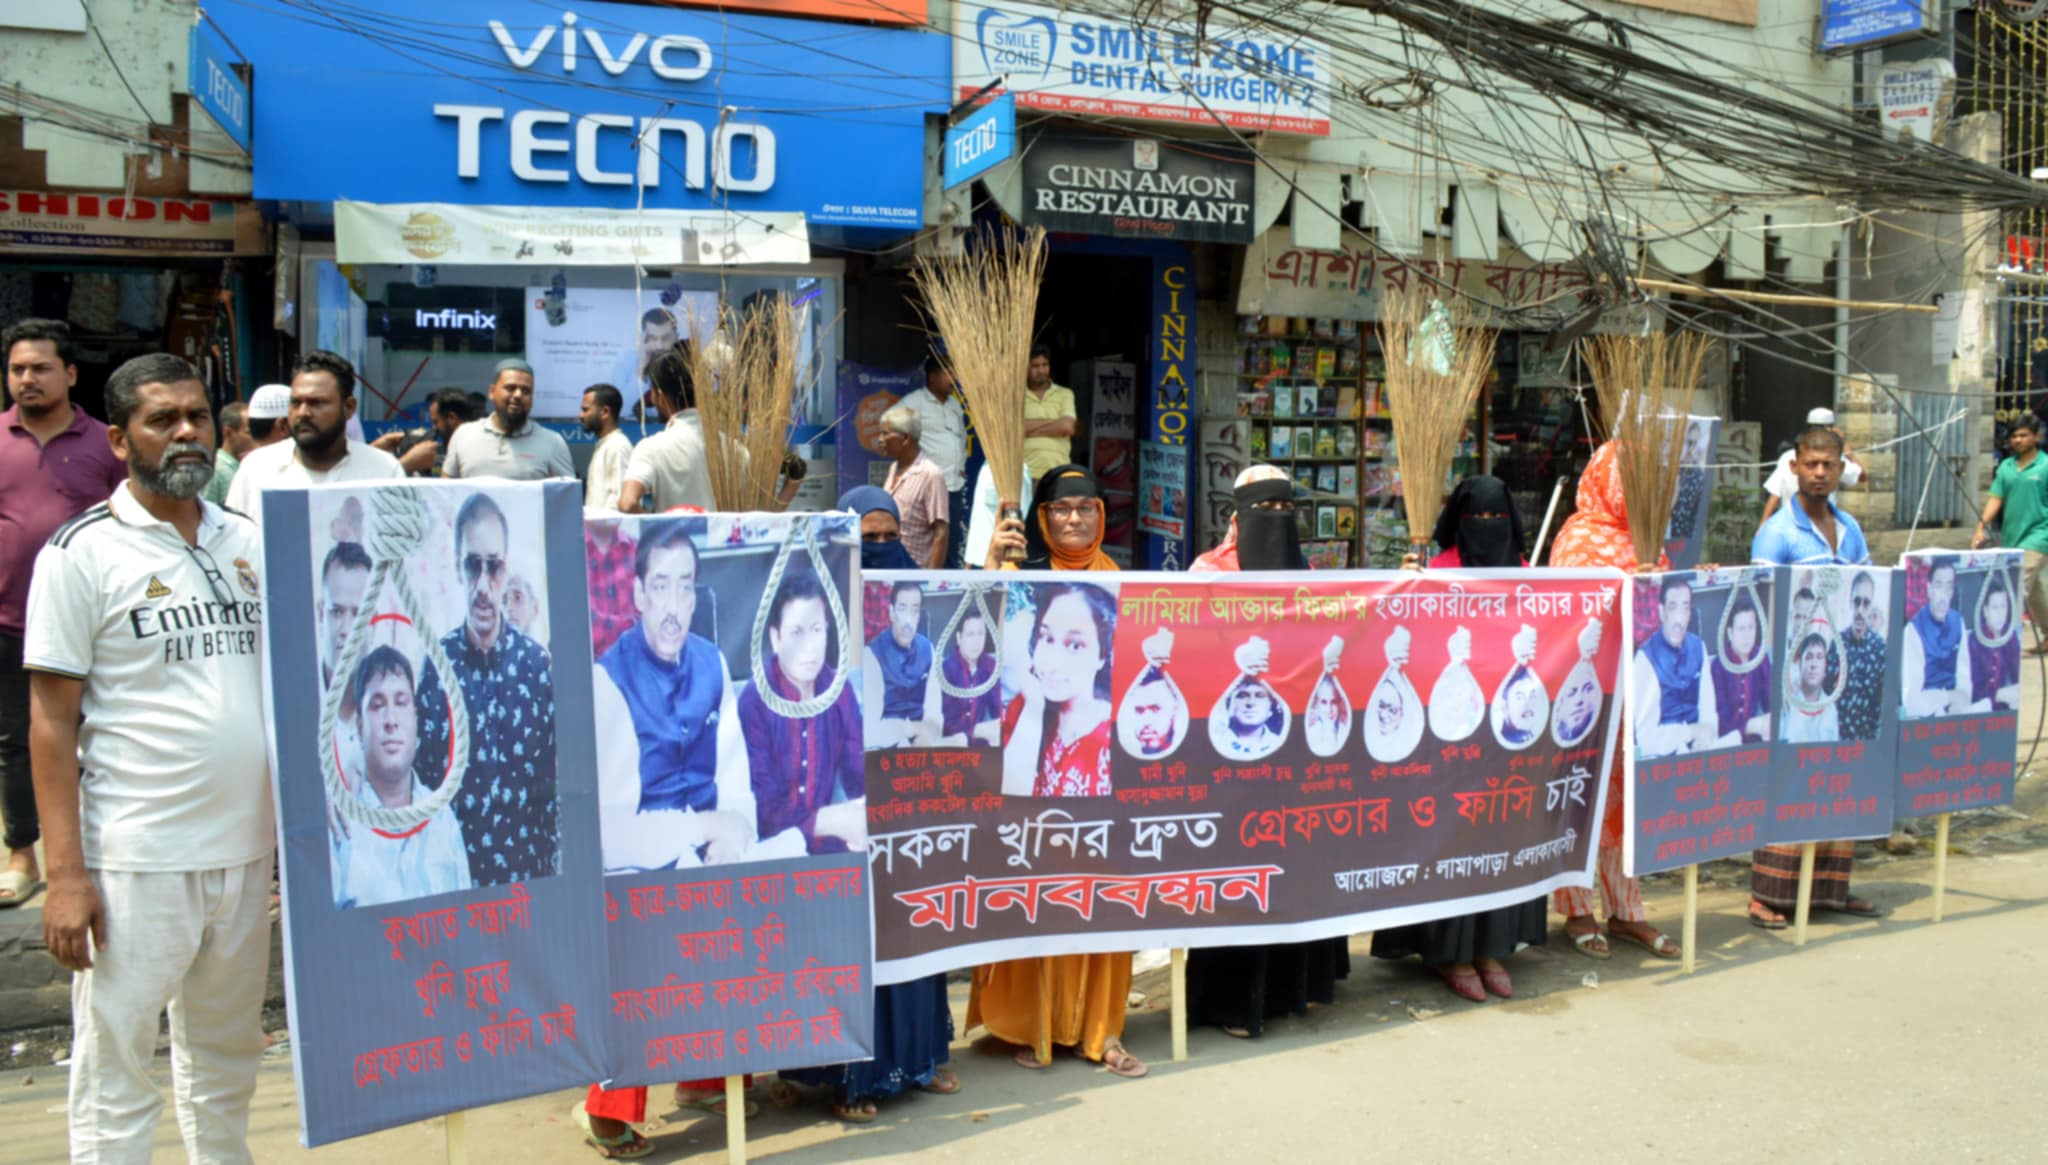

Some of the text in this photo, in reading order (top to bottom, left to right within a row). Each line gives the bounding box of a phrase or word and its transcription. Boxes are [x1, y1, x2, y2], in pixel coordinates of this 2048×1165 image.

[488, 11, 713, 80] vivo
[994, 30, 1040, 49] SMILE
[994, 49, 1041, 67] ZONE
[1070, 21, 1316, 80] SMILE ZONE
[207, 57, 243, 128] TECNO
[1071, 60, 1174, 94] DENTAL
[433, 104, 776, 193] TECNO
[954, 117, 996, 169] TECNO
[1035, 188, 1250, 225] RESTAURANT
[1048, 164, 1238, 199] CINNAMON
[415, 308, 497, 330] Infinix
[130, 596, 262, 640] Emirates
[1121, 587, 1203, 625] লামিয়া
[1208, 594, 1286, 625] আক্তার
[1374, 582, 1508, 620] হত্যাকারীদের
[1515, 584, 1573, 618] বিচার
[1580, 584, 1616, 617] চাই
[165, 630, 256, 664] FLY BETTER
[866, 822, 978, 875] সকল
[997, 808, 1116, 869] খুনির
[1130, 812, 1225, 863] দ্রুত
[1239, 796, 1394, 849] গ্রেফতার
[1407, 796, 1438, 828] ও
[1453, 773, 1537, 827] ফাঁসি
[1545, 765, 1593, 812] চাই
[1334, 862, 1420, 893] আয়োজনে
[1435, 850, 1510, 880] লামাপাড়া
[1512, 827, 1578, 869] এলাকাবাসী
[381, 882, 532, 961] কুখ্যাত সন্ত্রাসী
[604, 866, 863, 923] ৬ ছাত্র-জনতা হত্যা মামলার
[893, 864, 1285, 931] মানববন্ধন
[676, 912, 787, 963] আসামি খুনি
[415, 960, 456, 1018] খুনি
[611, 956, 862, 1024] সাংবাদিক ককটেল রবিনের
[353, 1000, 578, 1089] গ্রেফতার ও ফাঁসি চাই
[645, 1005, 845, 1070] গ্রেফতার ও ফাঁসি চাই
